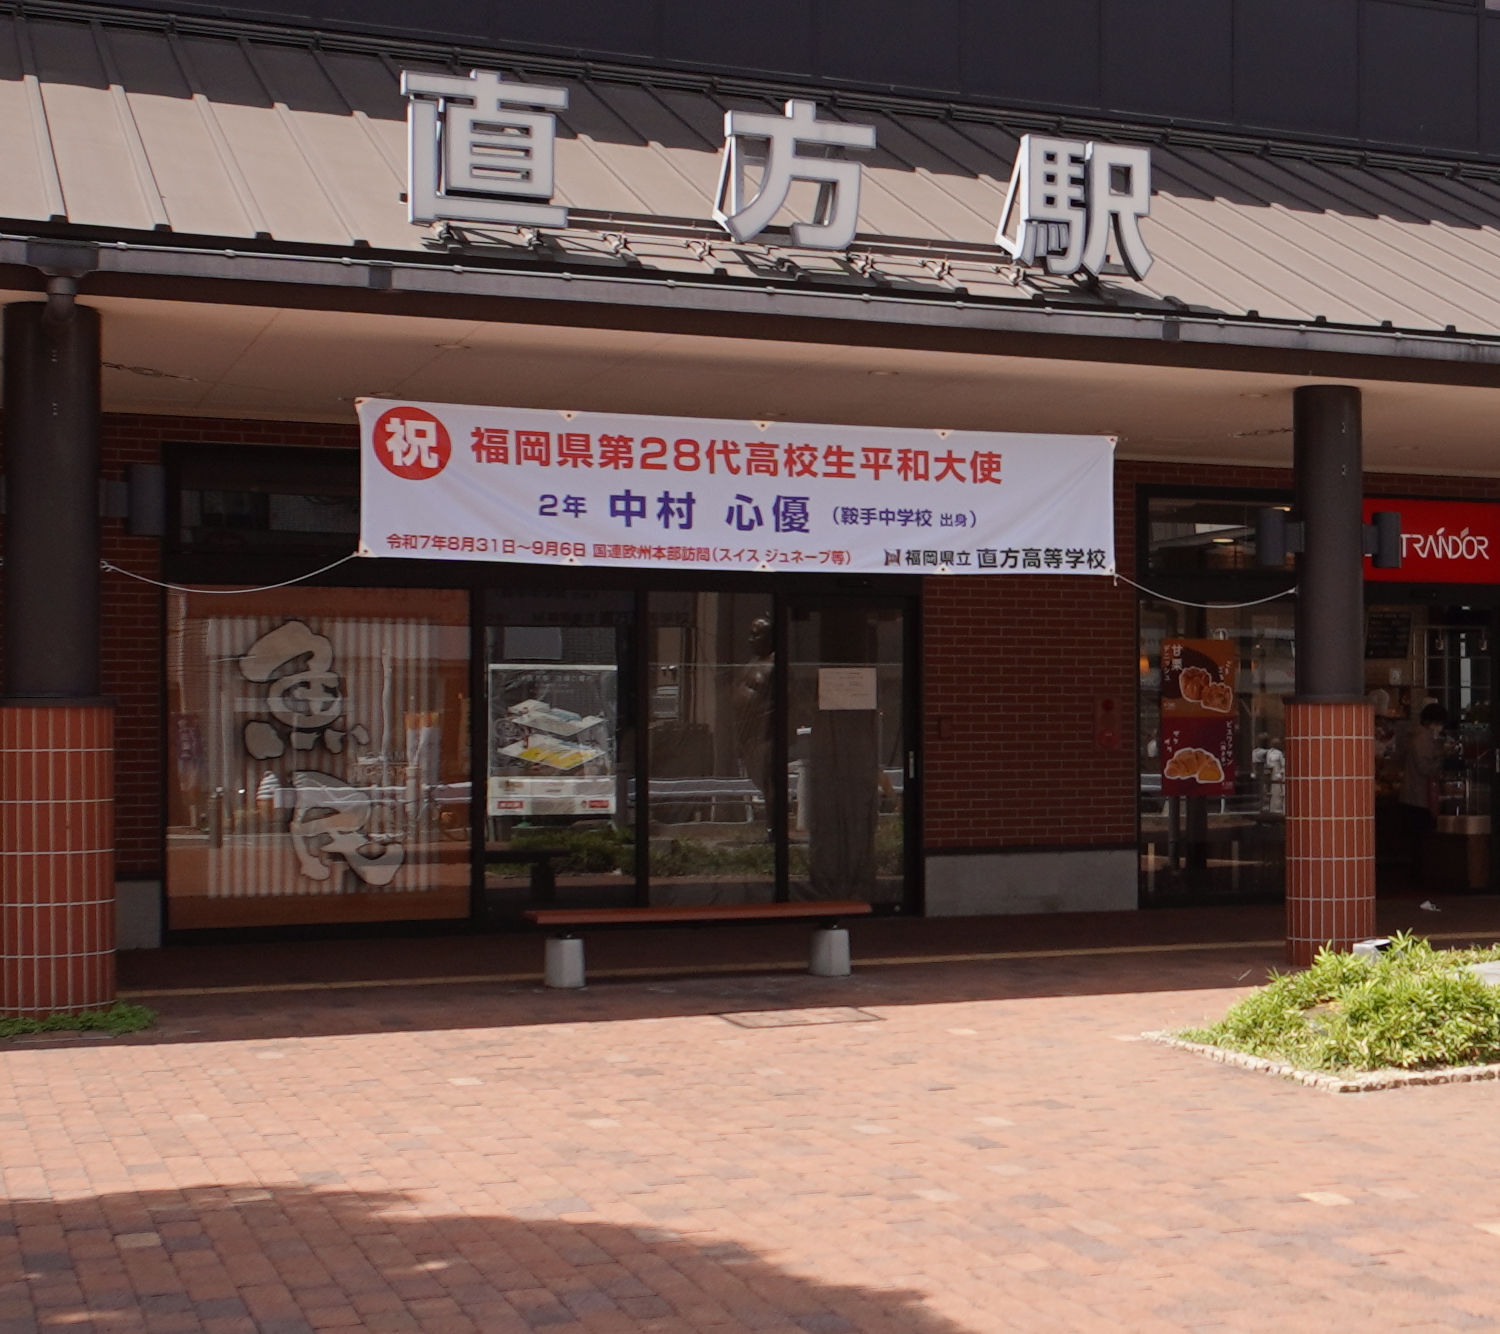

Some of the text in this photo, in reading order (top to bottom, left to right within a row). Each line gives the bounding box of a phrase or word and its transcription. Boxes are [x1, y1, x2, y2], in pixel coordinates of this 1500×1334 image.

[400, 68, 1155, 282] 直方駅
[384, 417, 440, 469] 祝
[470, 426, 1004, 486] 福岡県第28代高校生平和大使
[538, 494, 588, 519] 2年
[609, 488, 697, 530] 中村
[725, 493, 811, 534] 心優
[905, 547, 1107, 570] 福岡県立 直方高等学校
